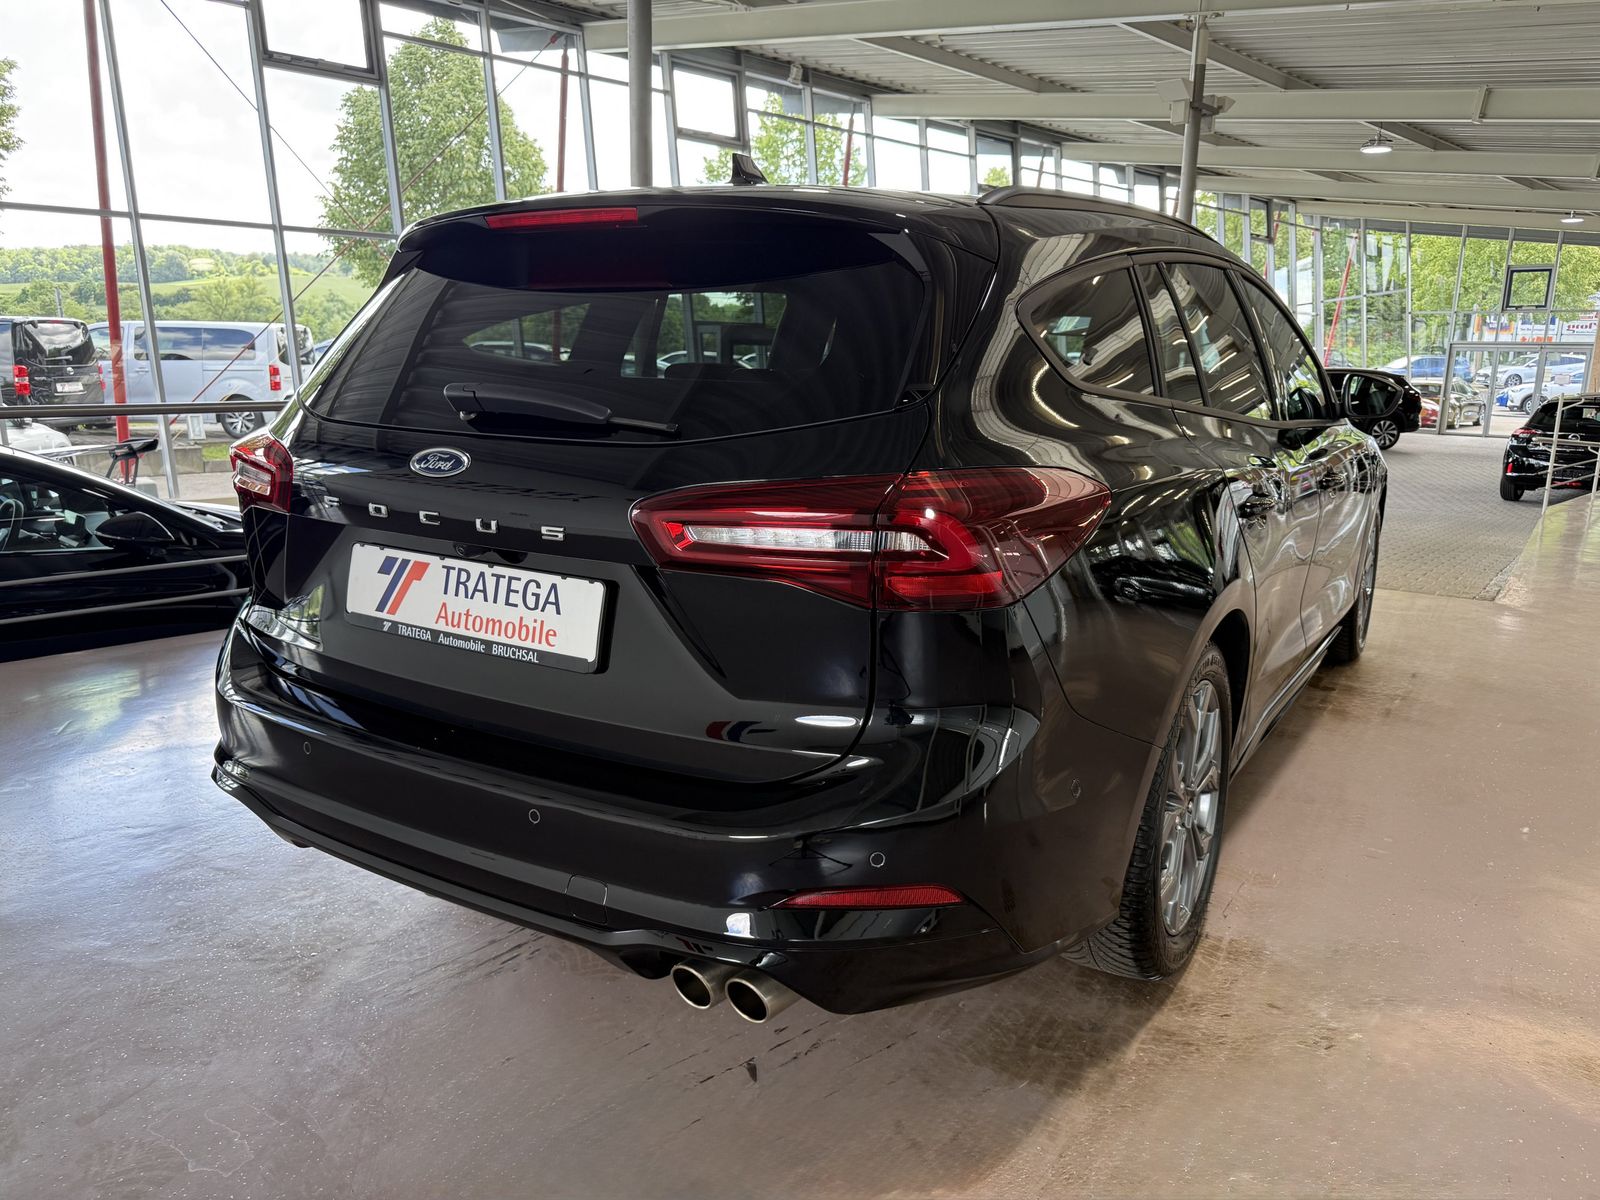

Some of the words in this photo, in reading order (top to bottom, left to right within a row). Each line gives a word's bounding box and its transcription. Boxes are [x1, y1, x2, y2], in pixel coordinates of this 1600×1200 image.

[421, 452, 456, 471] Ford
[324, 495, 565, 541] FOCUS
[441, 564, 562, 616] TRATEGA
[397, 624, 432, 642] TRATEGA
[437, 633, 487, 653] Automobile
[492, 643, 540, 663] BRUCHSAL
[434, 601, 558, 648] Automobile
